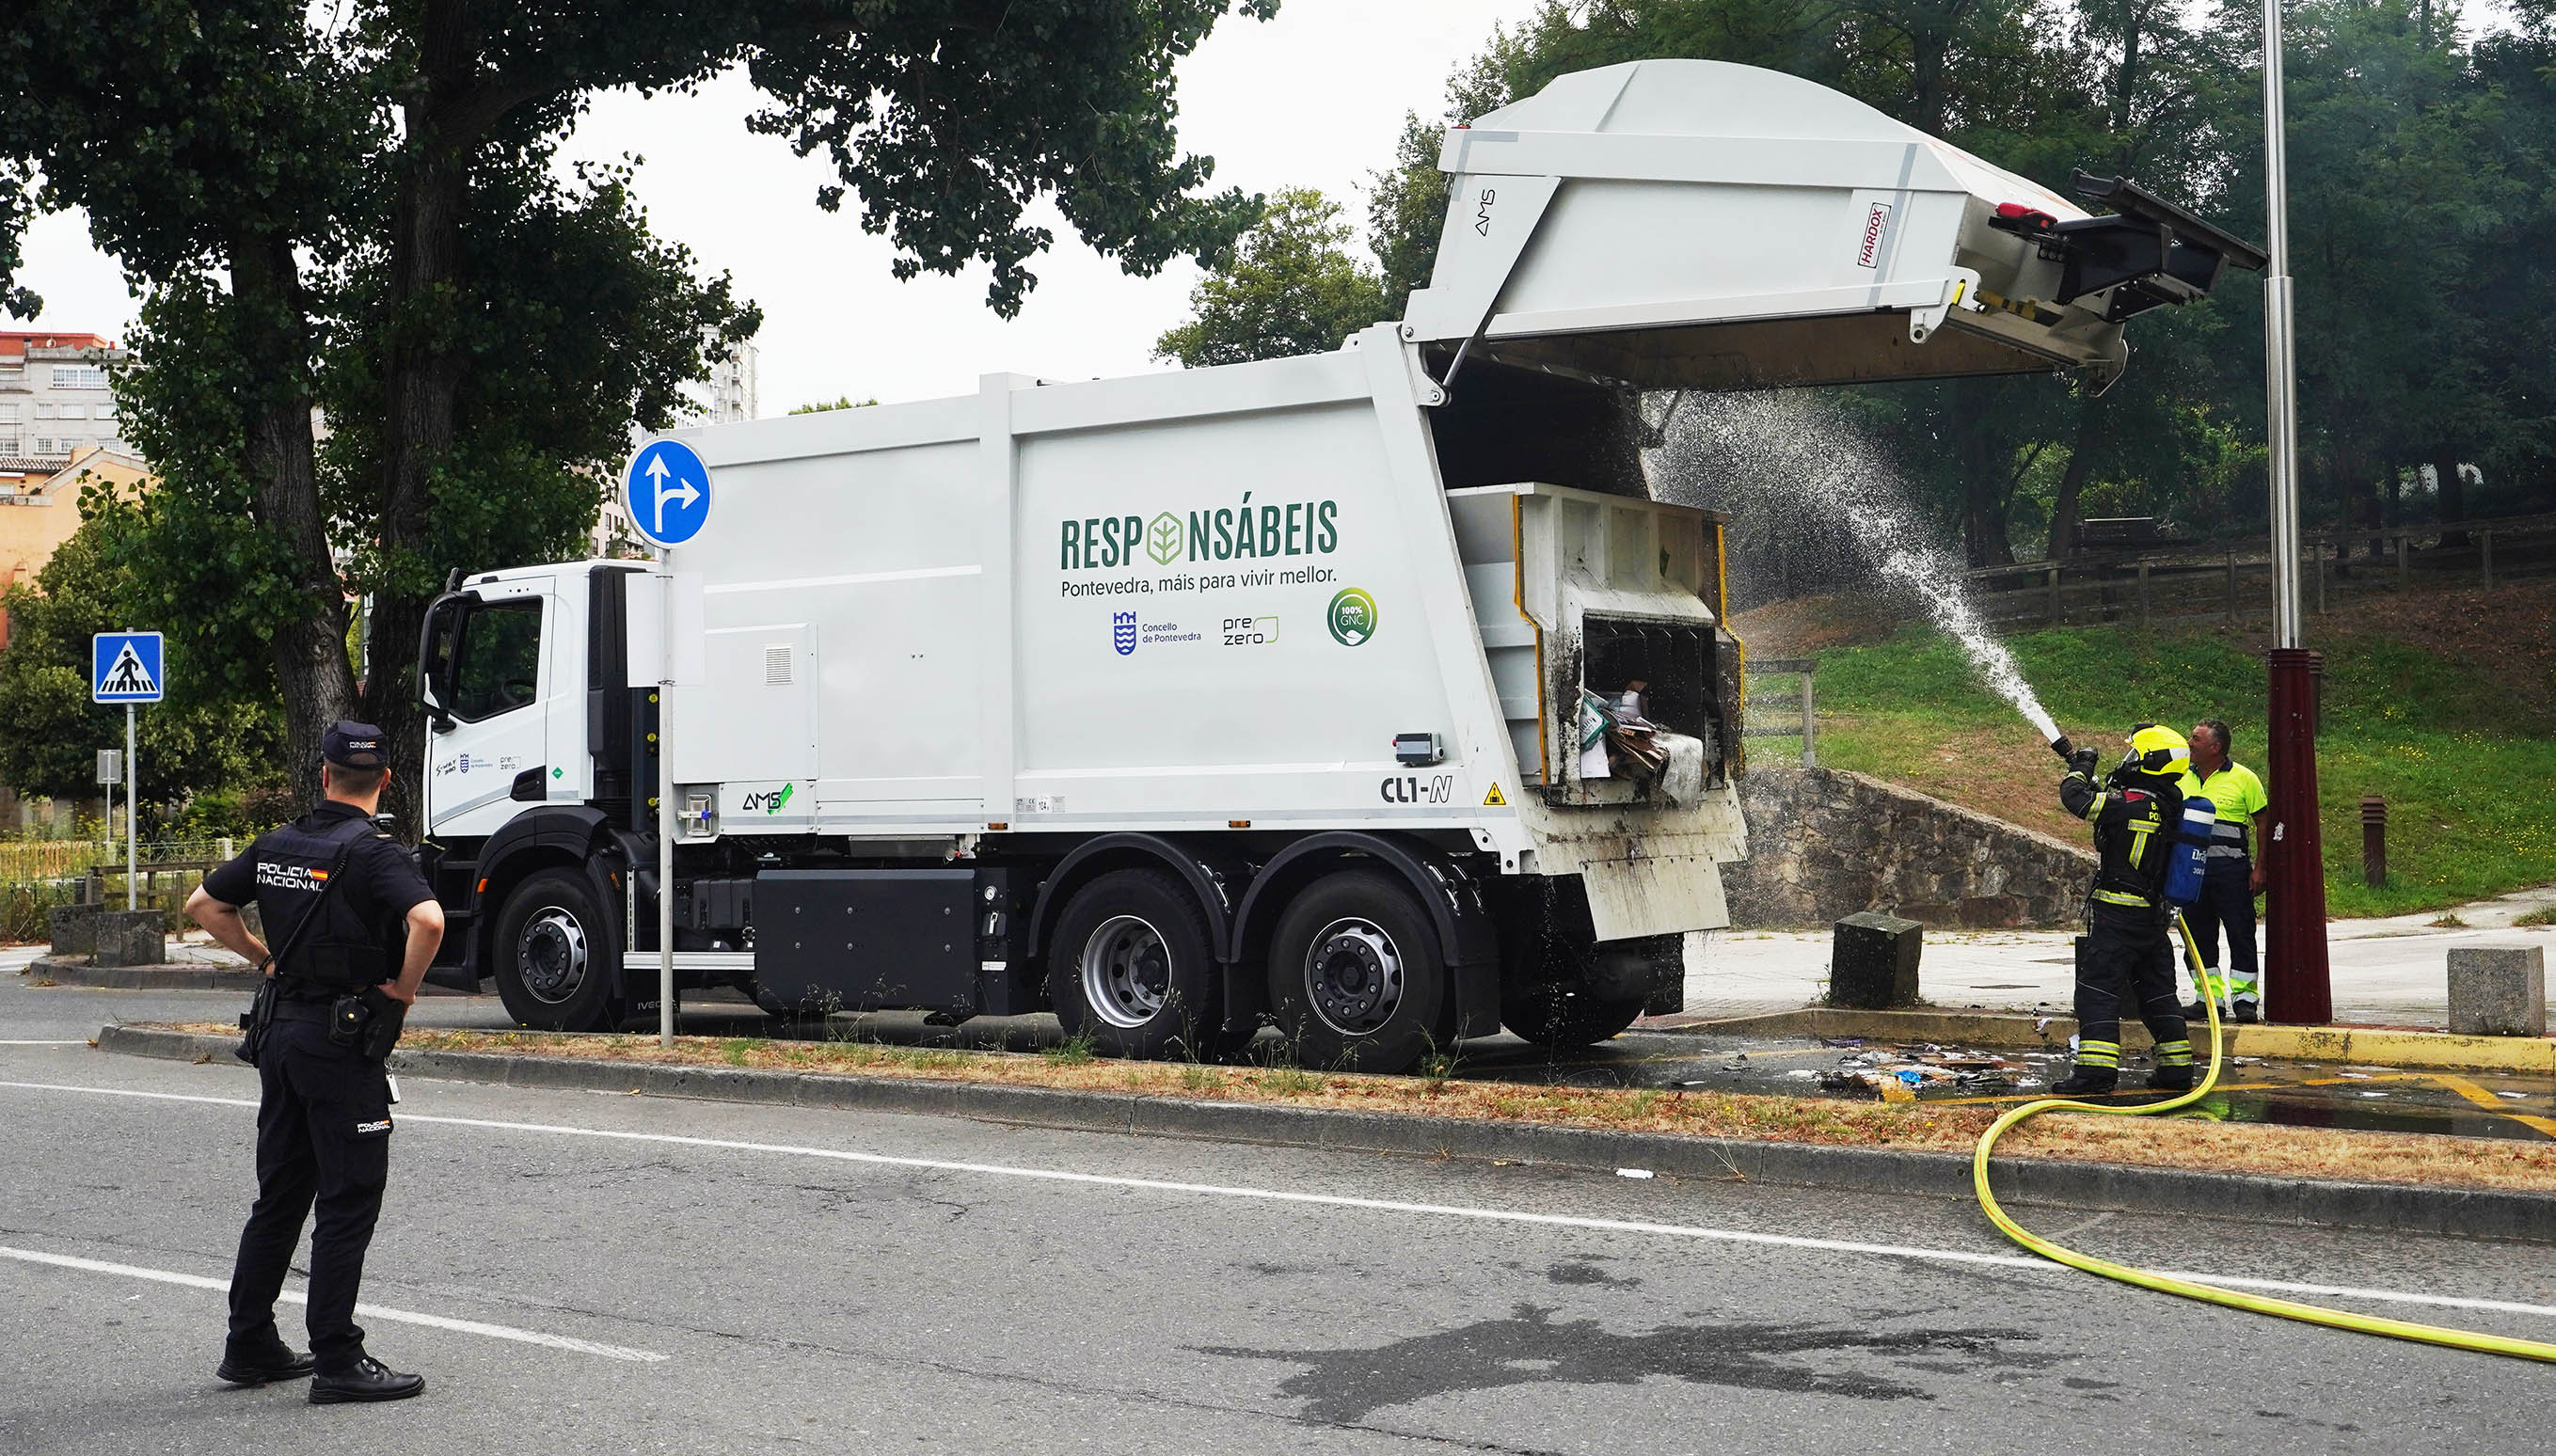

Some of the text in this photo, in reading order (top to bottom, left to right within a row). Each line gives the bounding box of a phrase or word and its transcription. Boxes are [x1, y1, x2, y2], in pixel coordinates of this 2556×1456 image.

[1475, 189, 1495, 237] AMS
[1862, 208, 1882, 263] HARDOX
[1061, 568, 1337, 597] Pontevedra, máis para vivir mellor.
[1342, 606, 1363, 614] 100%
[1142, 623, 1178, 632] Concello
[1223, 617, 1252, 632] pre
[1341, 614, 1364, 625] GNC
[1142, 632, 1201, 643] de Pontevedra
[1224, 633, 1264, 645] zero
[1381, 775, 1453, 803] CL1-N
[742, 791, 782, 810] AMS
[257, 863, 313, 879] POLICIA
[257, 874, 325, 892] NACIONAL
